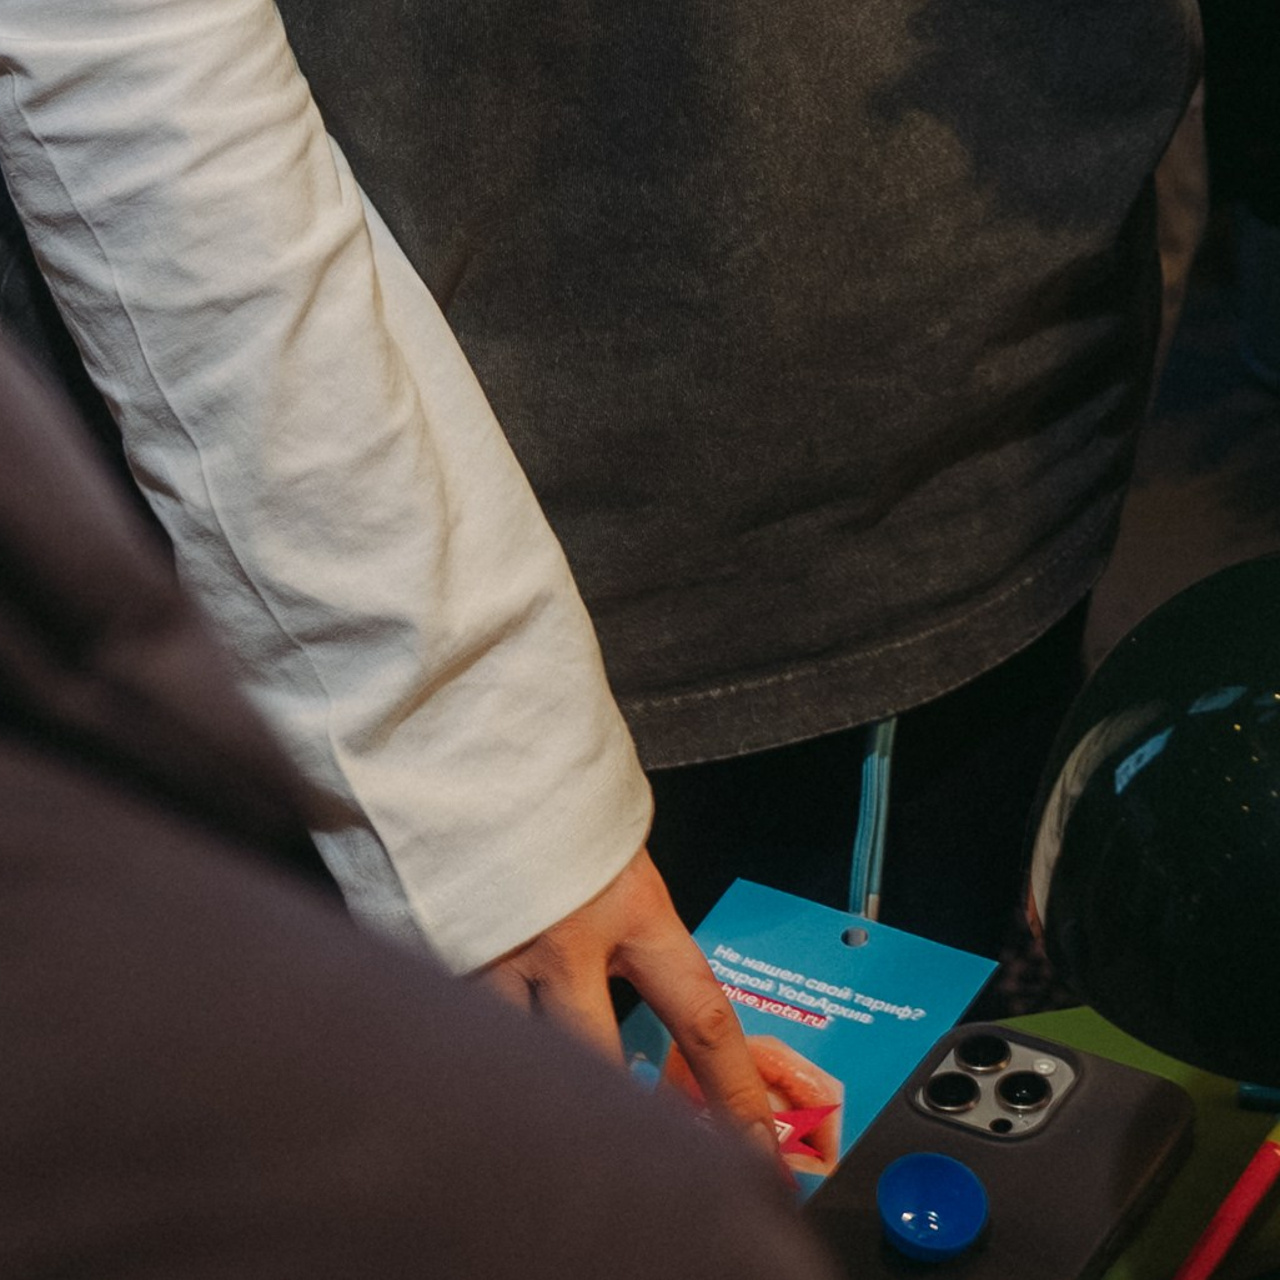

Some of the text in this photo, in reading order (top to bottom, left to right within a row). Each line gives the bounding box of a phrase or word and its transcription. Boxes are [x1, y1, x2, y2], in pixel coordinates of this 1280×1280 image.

[707, 959, 875, 1024] Открой YotaАрхив
[713, 944, 927, 1021] Не нашел свой тариф?
[720, 982, 834, 1029] hive.yota.ru
